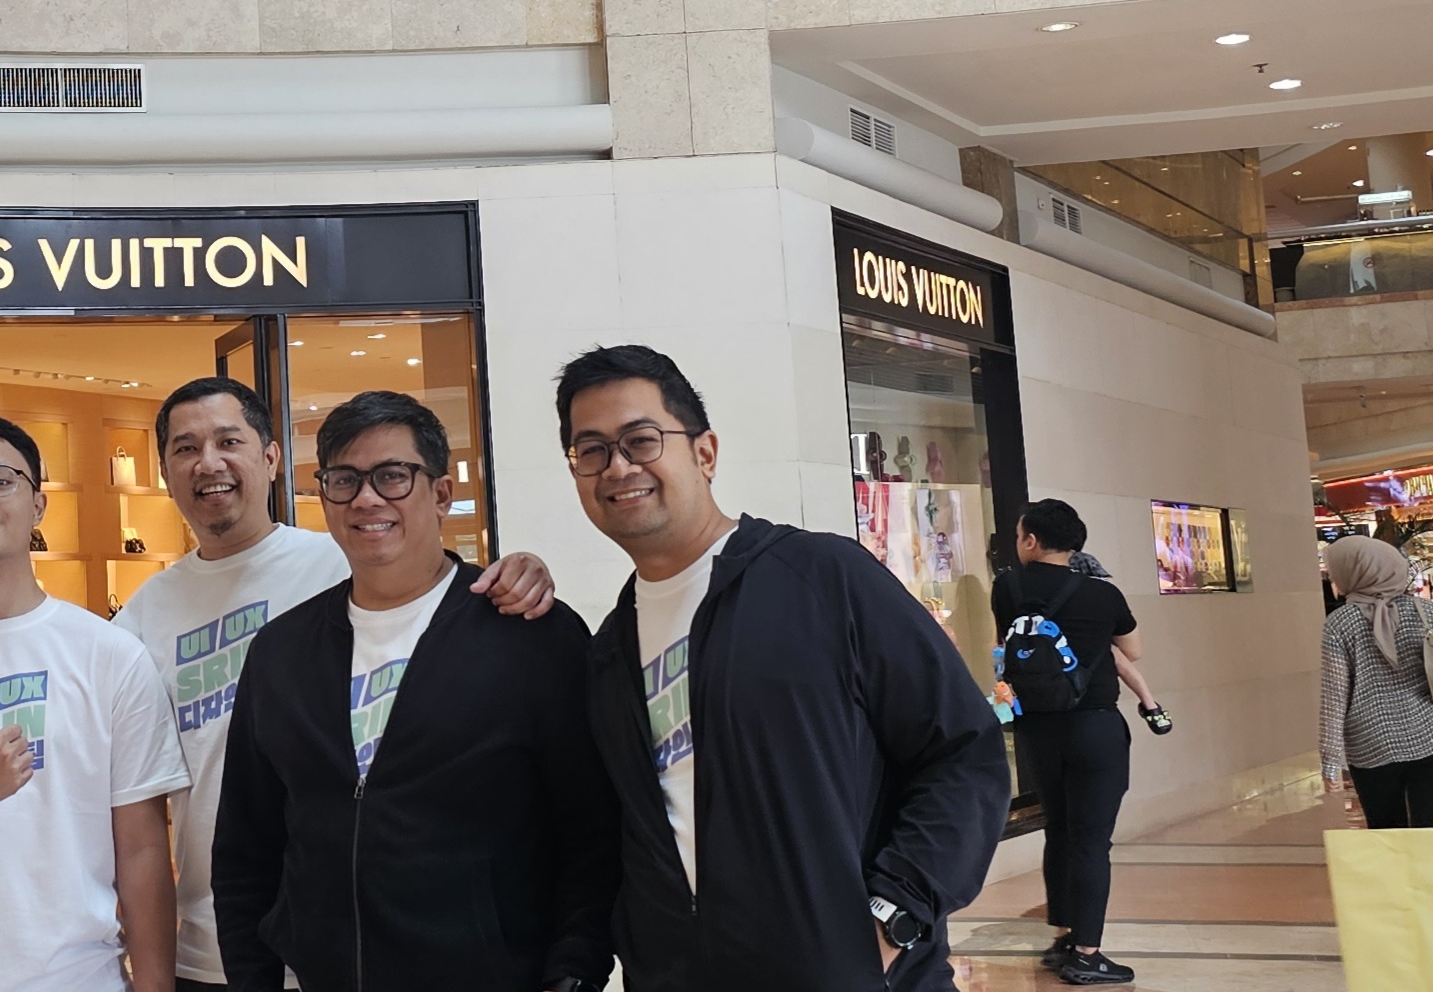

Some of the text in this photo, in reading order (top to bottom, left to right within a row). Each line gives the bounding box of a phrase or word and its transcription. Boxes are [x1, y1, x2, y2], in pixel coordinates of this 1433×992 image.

[38, 234, 308, 292] VUITTON
[853, 247, 984, 329] LOUIS VUITTON
[180, 604, 266, 659] UI UX
[0, 675, 45, 705] UX
[176, 639, 253, 703] SRI
[178, 682, 238, 733] 디자
[351, 695, 396, 746] RI
[647, 676, 689, 748] RI
